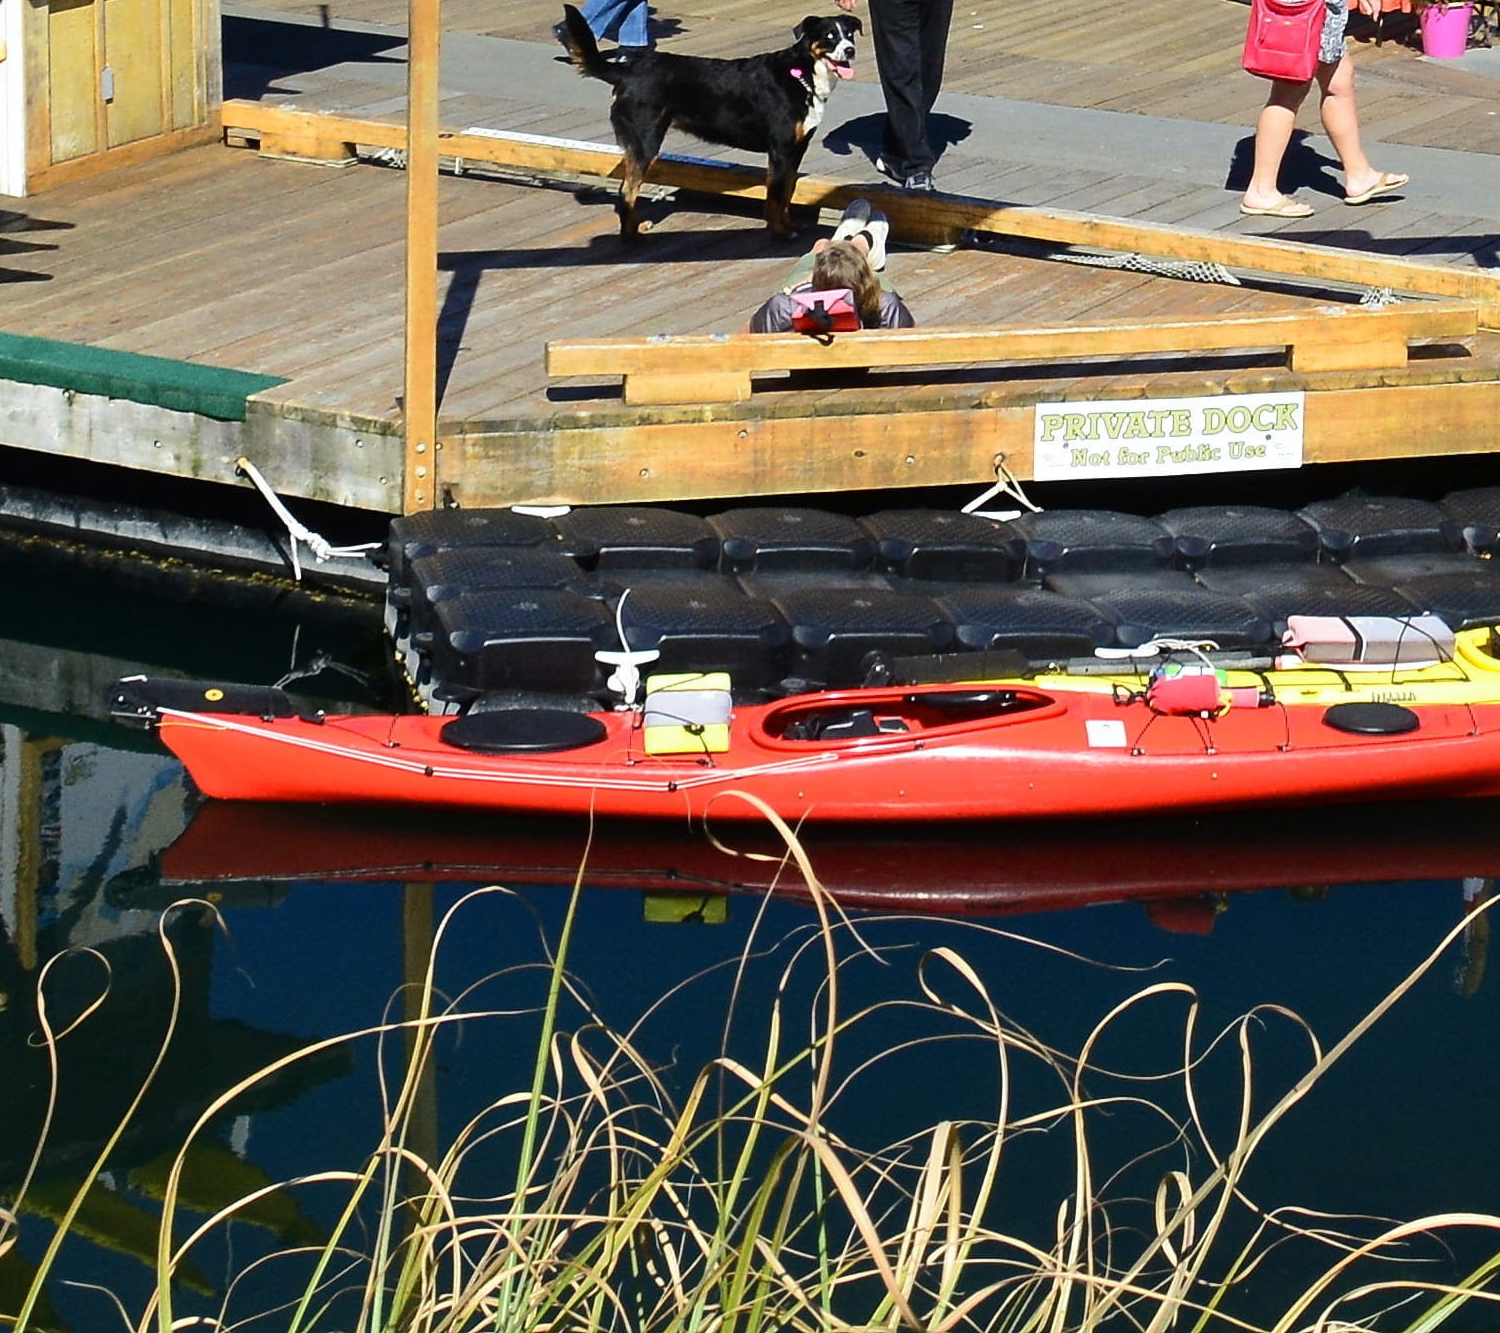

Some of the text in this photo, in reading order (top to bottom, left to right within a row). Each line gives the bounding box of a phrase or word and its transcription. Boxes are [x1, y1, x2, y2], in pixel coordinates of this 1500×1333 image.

[1041, 403, 1299, 442] PRIVATE DOCK
[1070, 441, 1267, 467] Not for Public Use
